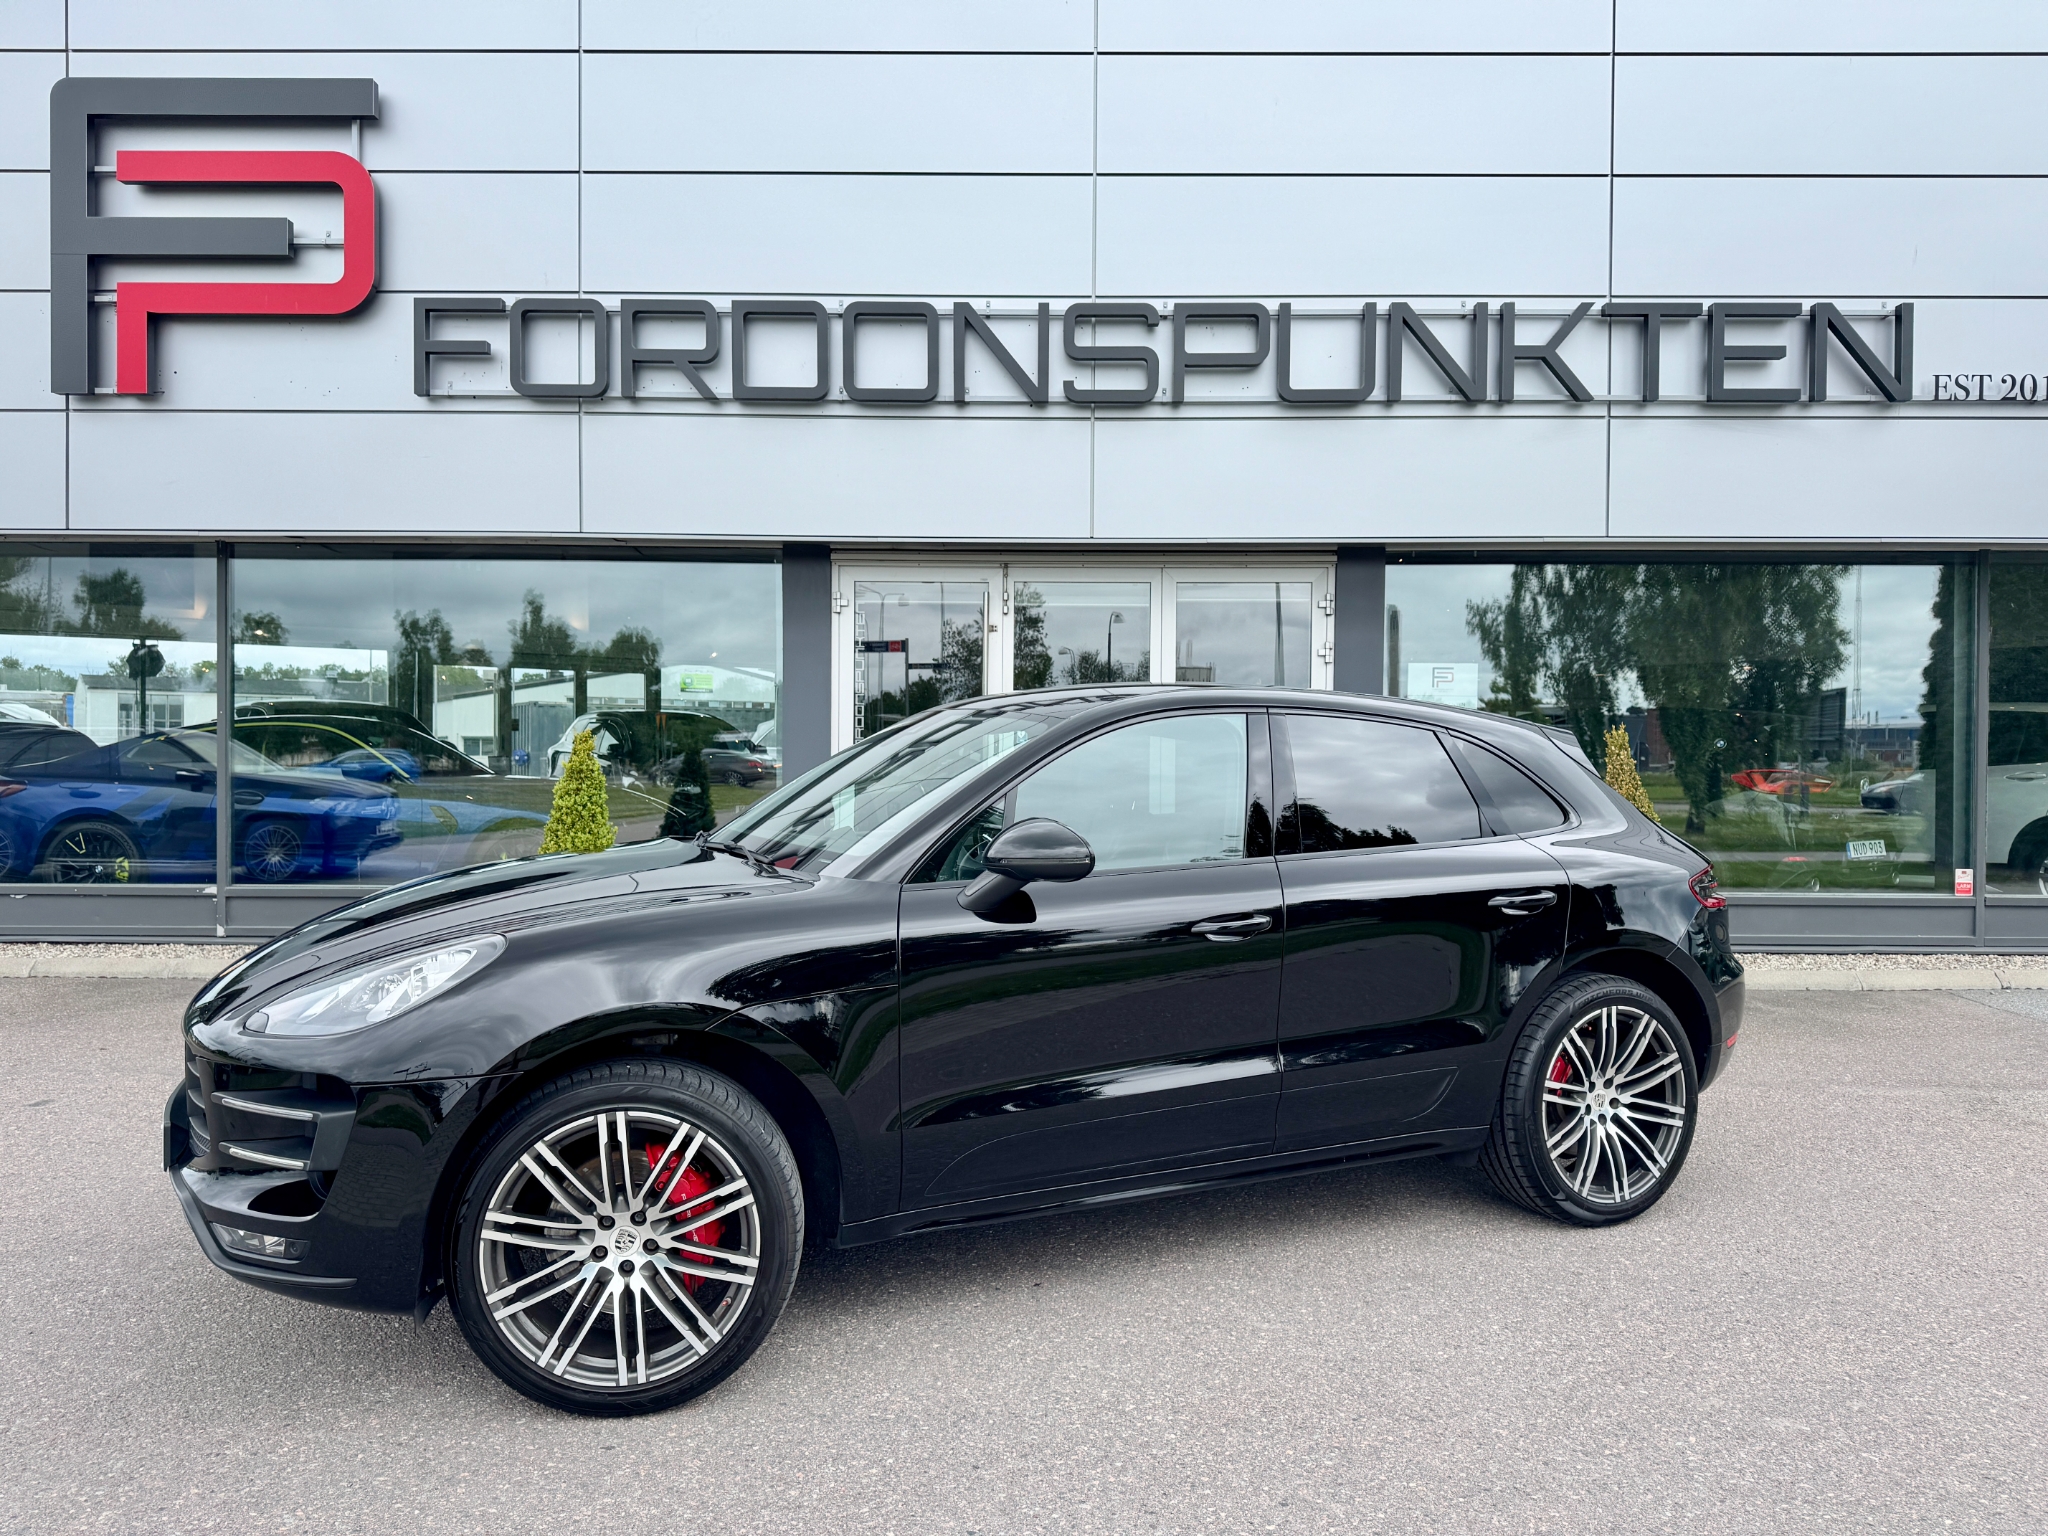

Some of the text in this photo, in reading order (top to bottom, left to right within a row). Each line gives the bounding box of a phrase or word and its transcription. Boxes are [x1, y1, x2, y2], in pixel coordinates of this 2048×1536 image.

[413, 296, 1914, 404] FORDONSPUNKTEN
[1932, 374, 1993, 401] EST
[855, 603, 866, 744] RDONSPUNKTEN
[1868, 841, 1884, 855] 903
